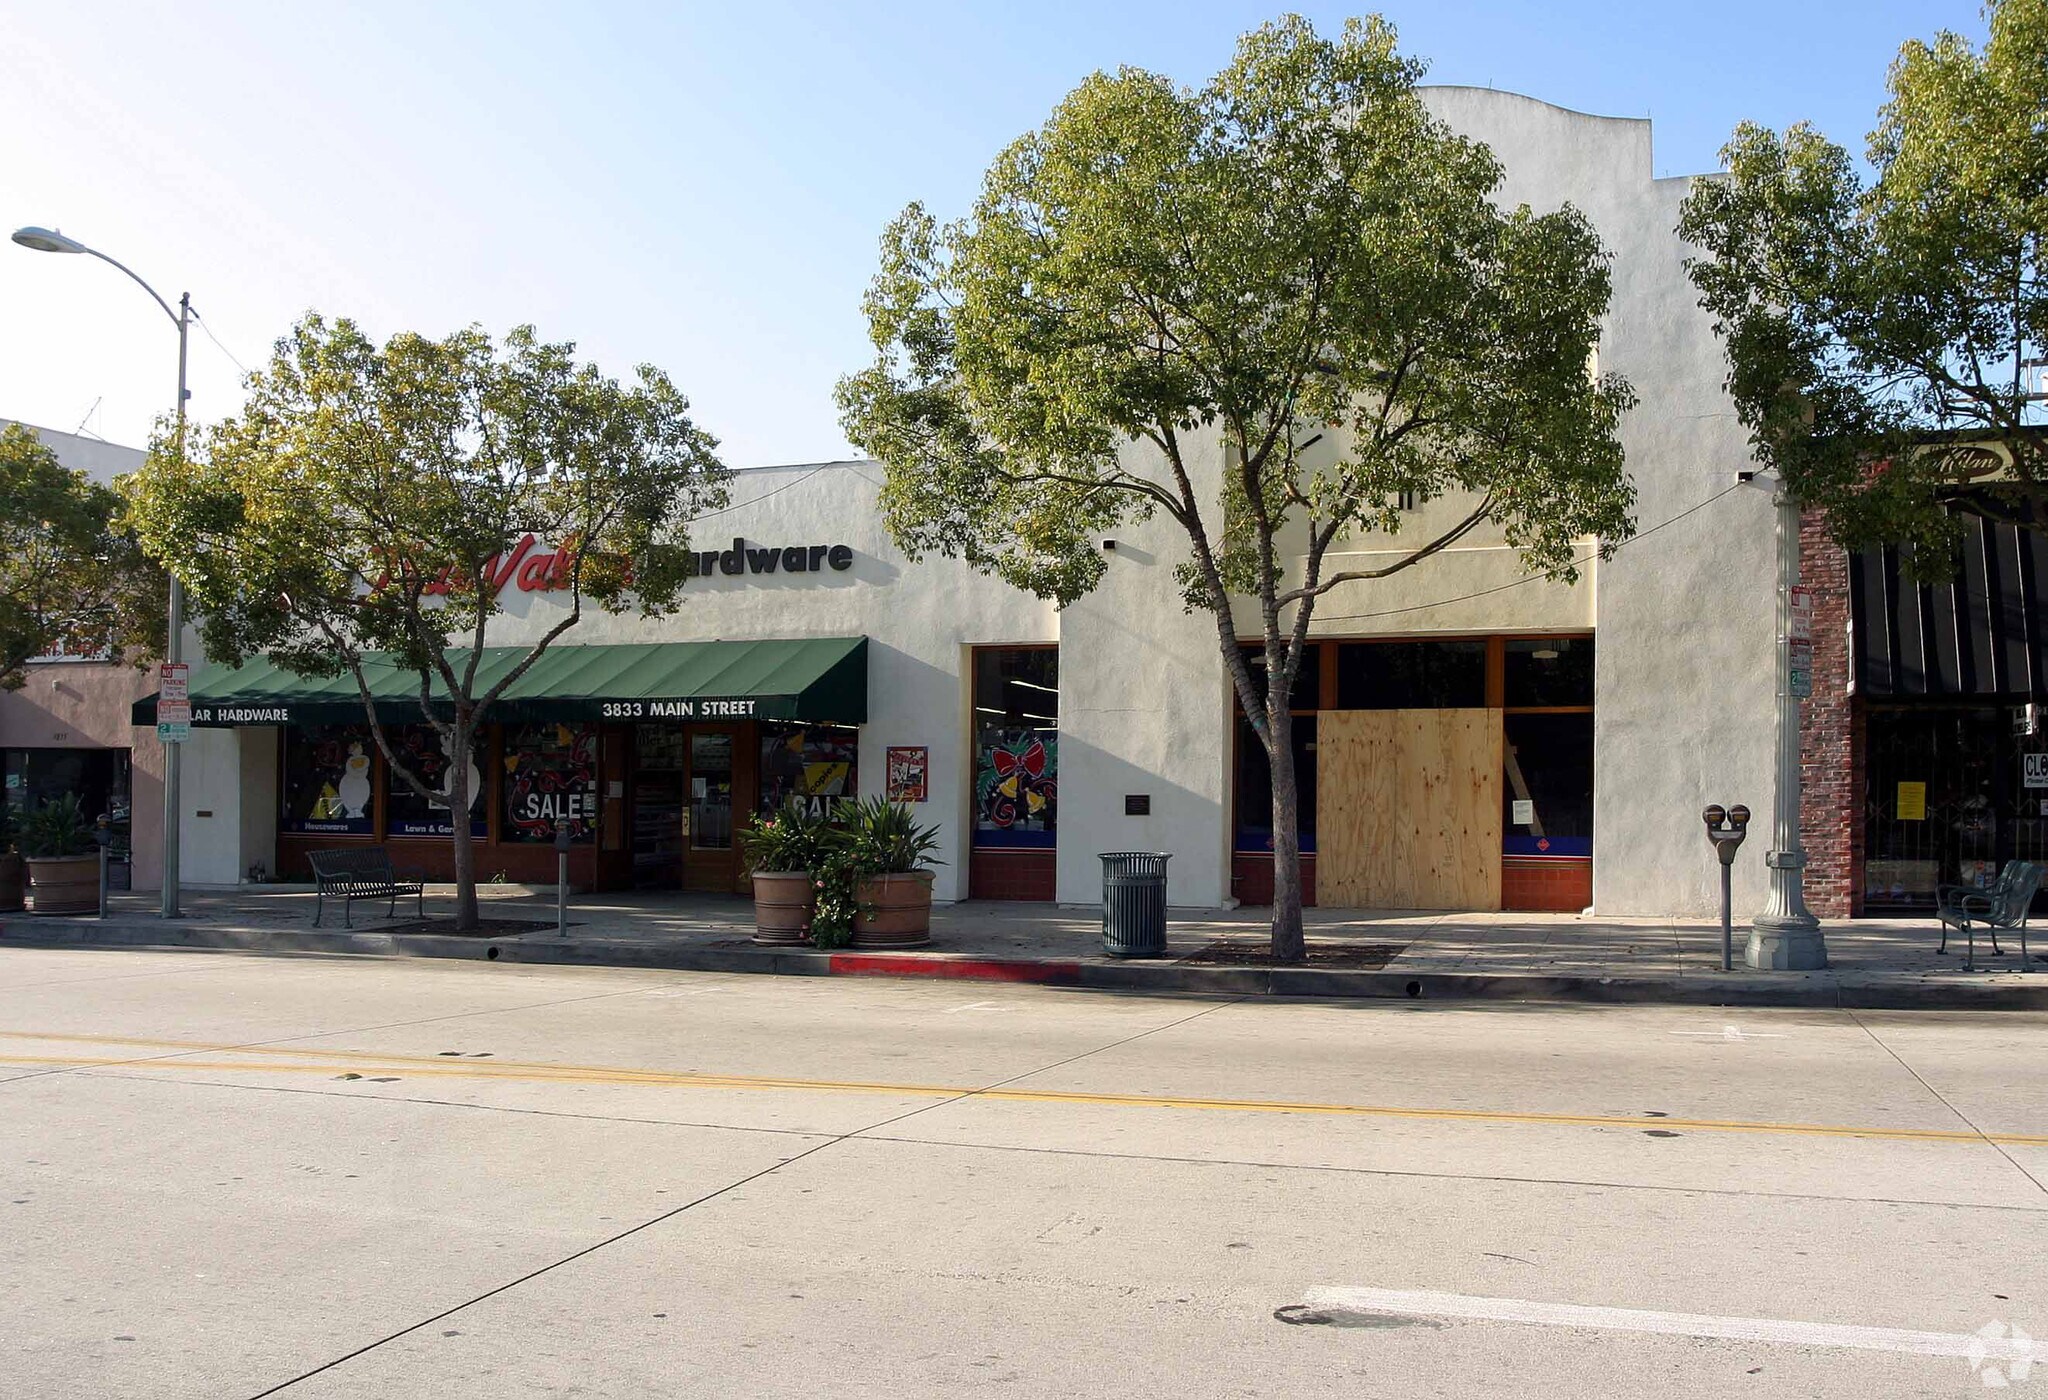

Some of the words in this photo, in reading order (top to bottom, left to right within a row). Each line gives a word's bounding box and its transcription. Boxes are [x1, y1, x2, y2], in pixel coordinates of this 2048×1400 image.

[218, 708, 289, 721] HARDWARE
[602, 702, 643, 717] 3833
[649, 702, 694, 716] MAIN
[701, 700, 756, 716] STREET
[527, 793, 581, 819] SALE
[304, 821, 349, 832] Housewares
[405, 824, 427, 833] Lawn
[438, 824, 456, 834] Gar
